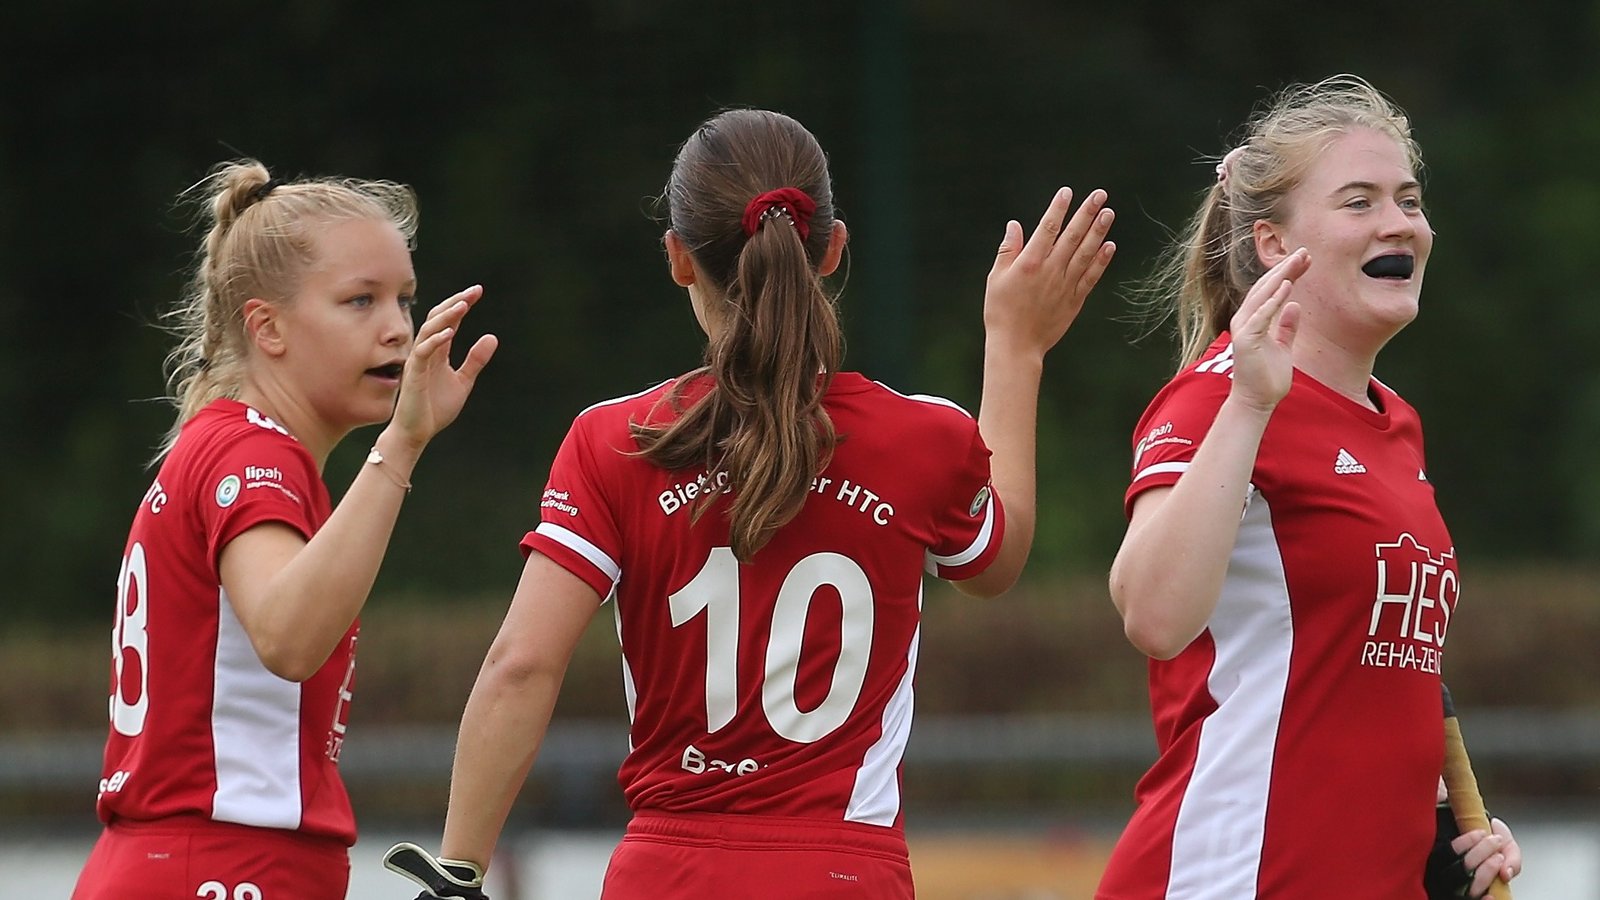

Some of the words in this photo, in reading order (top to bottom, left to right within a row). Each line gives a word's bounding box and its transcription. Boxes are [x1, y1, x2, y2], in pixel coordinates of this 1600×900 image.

[245, 466, 283, 481] lipah
[837, 479, 894, 525] HTC
[109, 541, 149, 736] 8
[668, 546, 874, 744] 10
[1368, 559, 1460, 648] HES
